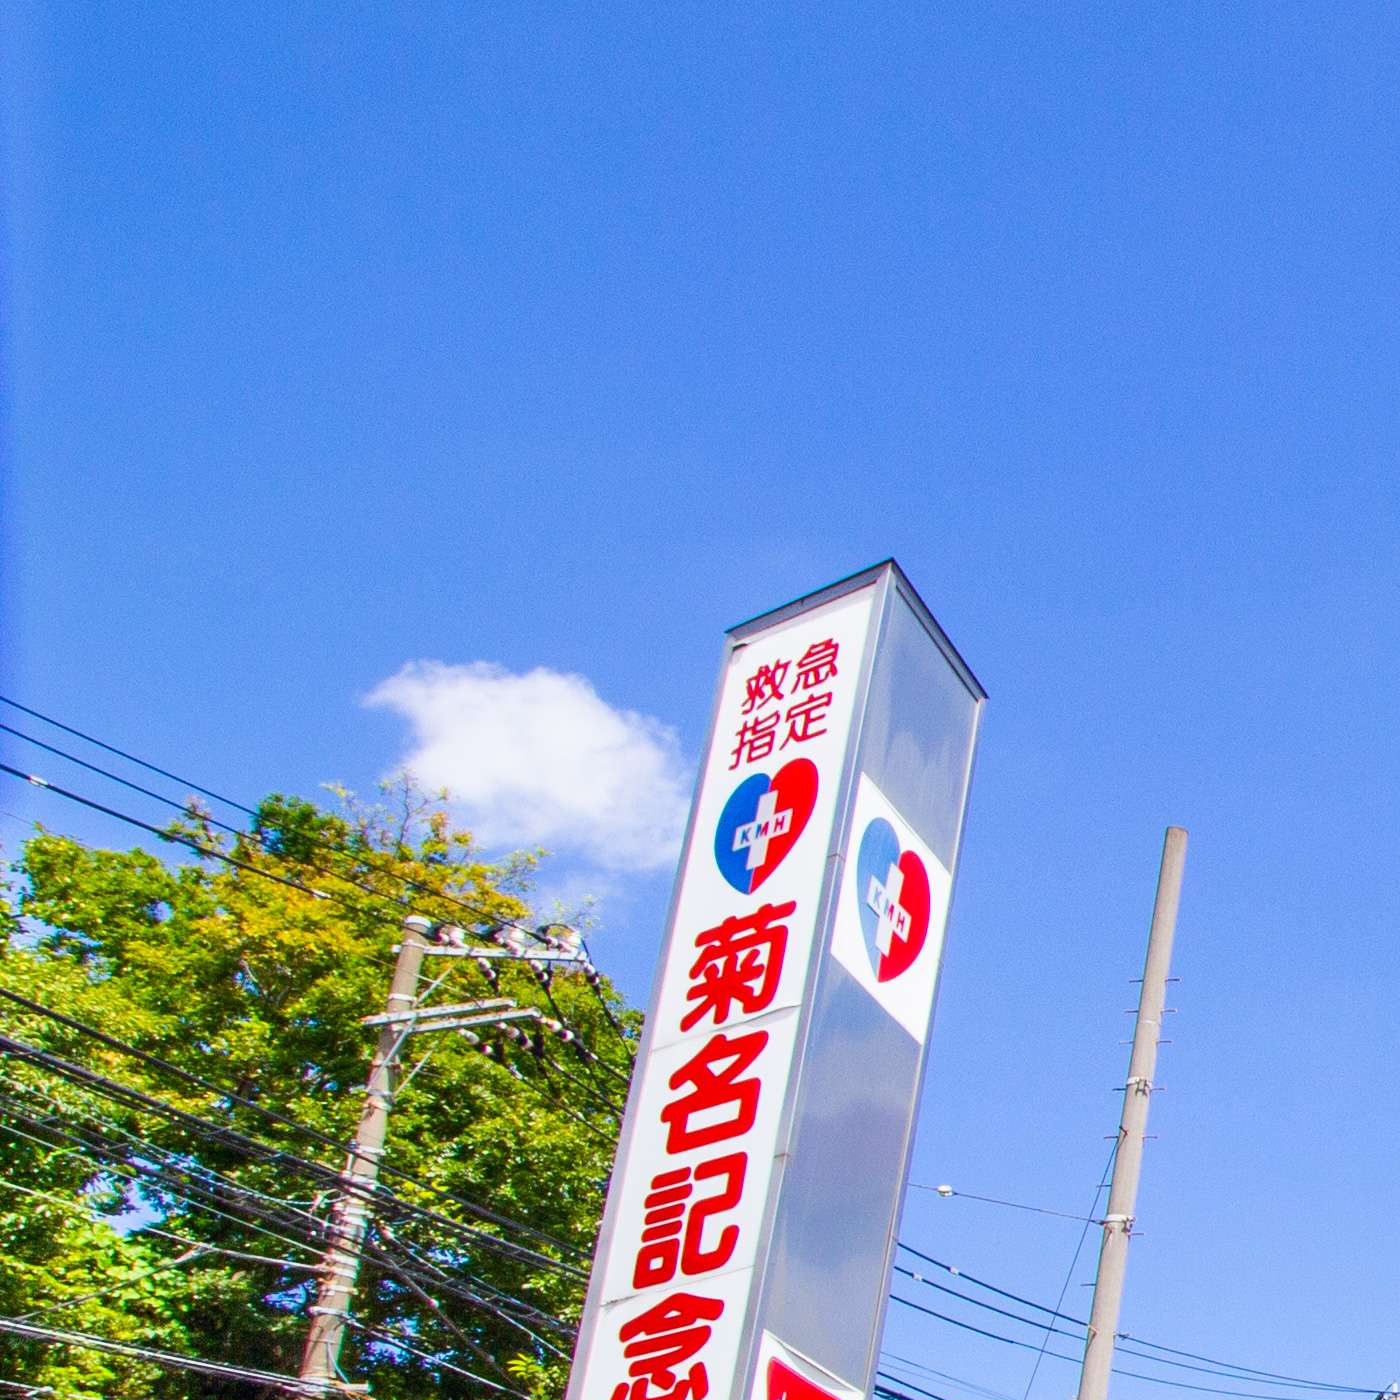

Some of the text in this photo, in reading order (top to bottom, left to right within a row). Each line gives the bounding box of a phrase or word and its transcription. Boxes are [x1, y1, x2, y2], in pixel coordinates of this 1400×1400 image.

[741, 638, 839, 715] 救急
[729, 693, 833, 770] 指定
[740, 816, 785, 845] KMH
